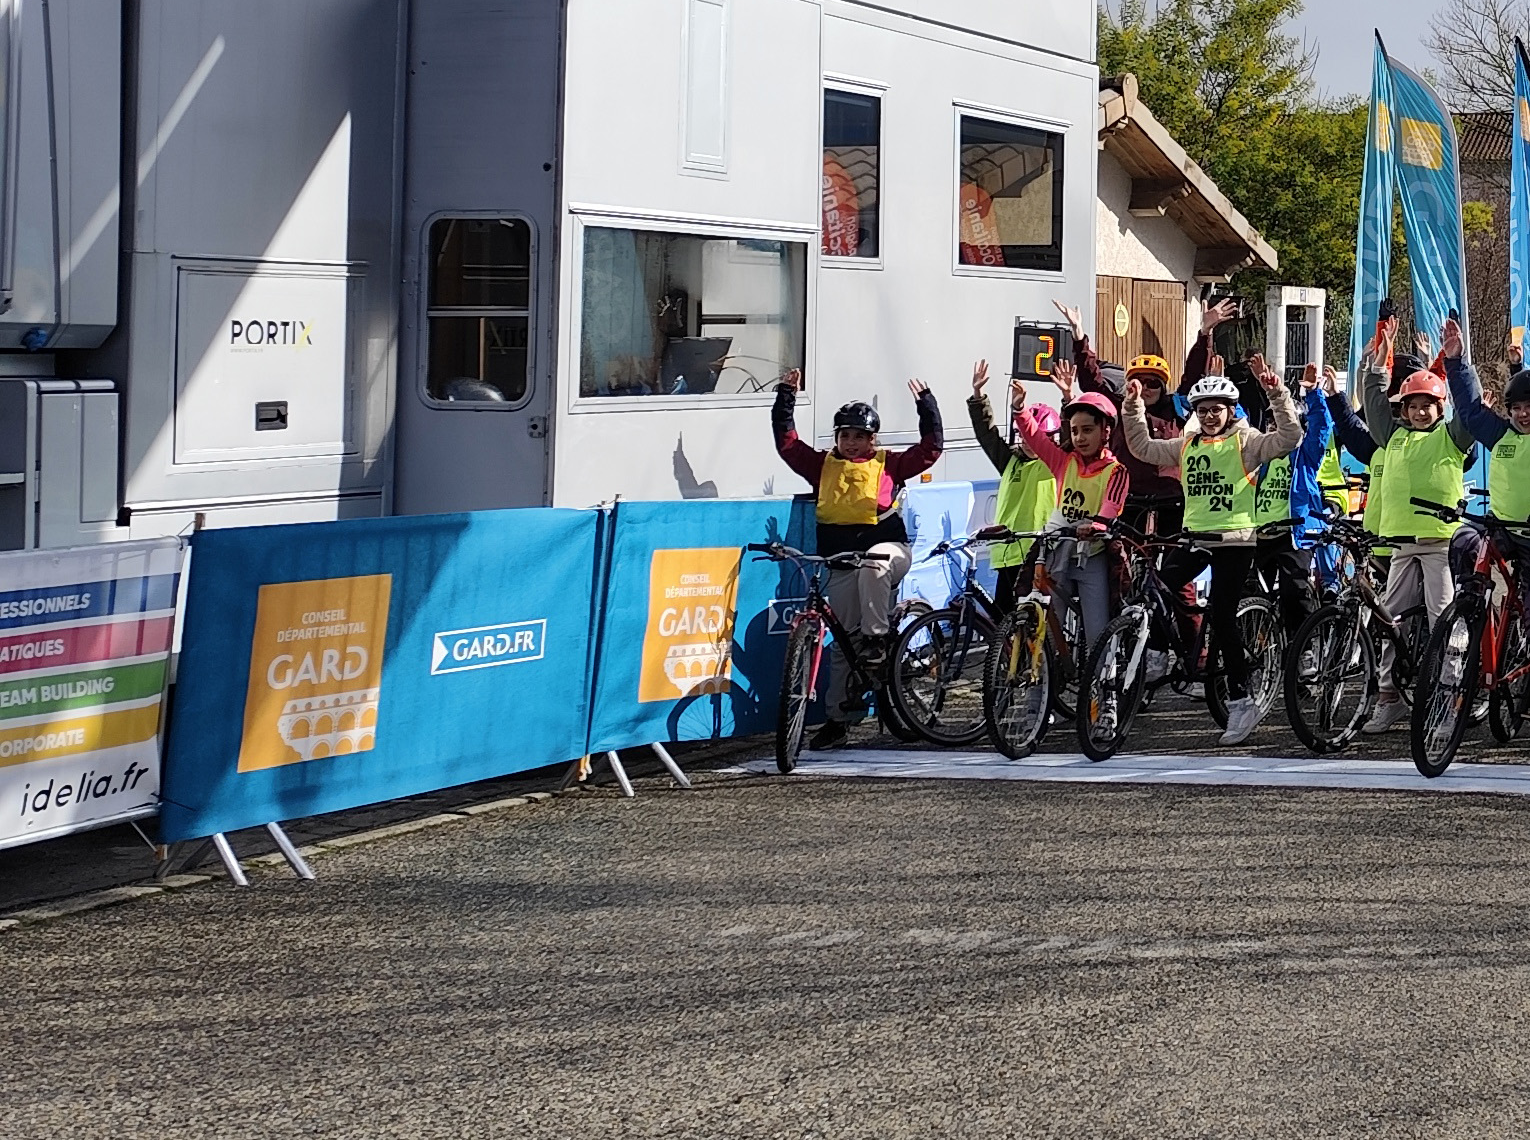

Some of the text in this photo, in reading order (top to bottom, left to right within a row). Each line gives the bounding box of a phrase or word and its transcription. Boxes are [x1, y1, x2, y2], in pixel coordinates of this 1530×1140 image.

[229, 319, 315, 346] PORTIX
[1035, 335, 1054, 376] 2
[1209, 495, 1233, 512] 24
[301, 608, 347, 625] CONSEIL
[658, 605, 725, 637] GARD
[276, 621, 367, 643] DÉPARTEMENTAL
[452, 629, 535, 661] GARD.FR
[266, 645, 369, 690] GARD
[41, 676, 115, 702] BUILDING
[20, 760, 150, 817] idelia.fr
